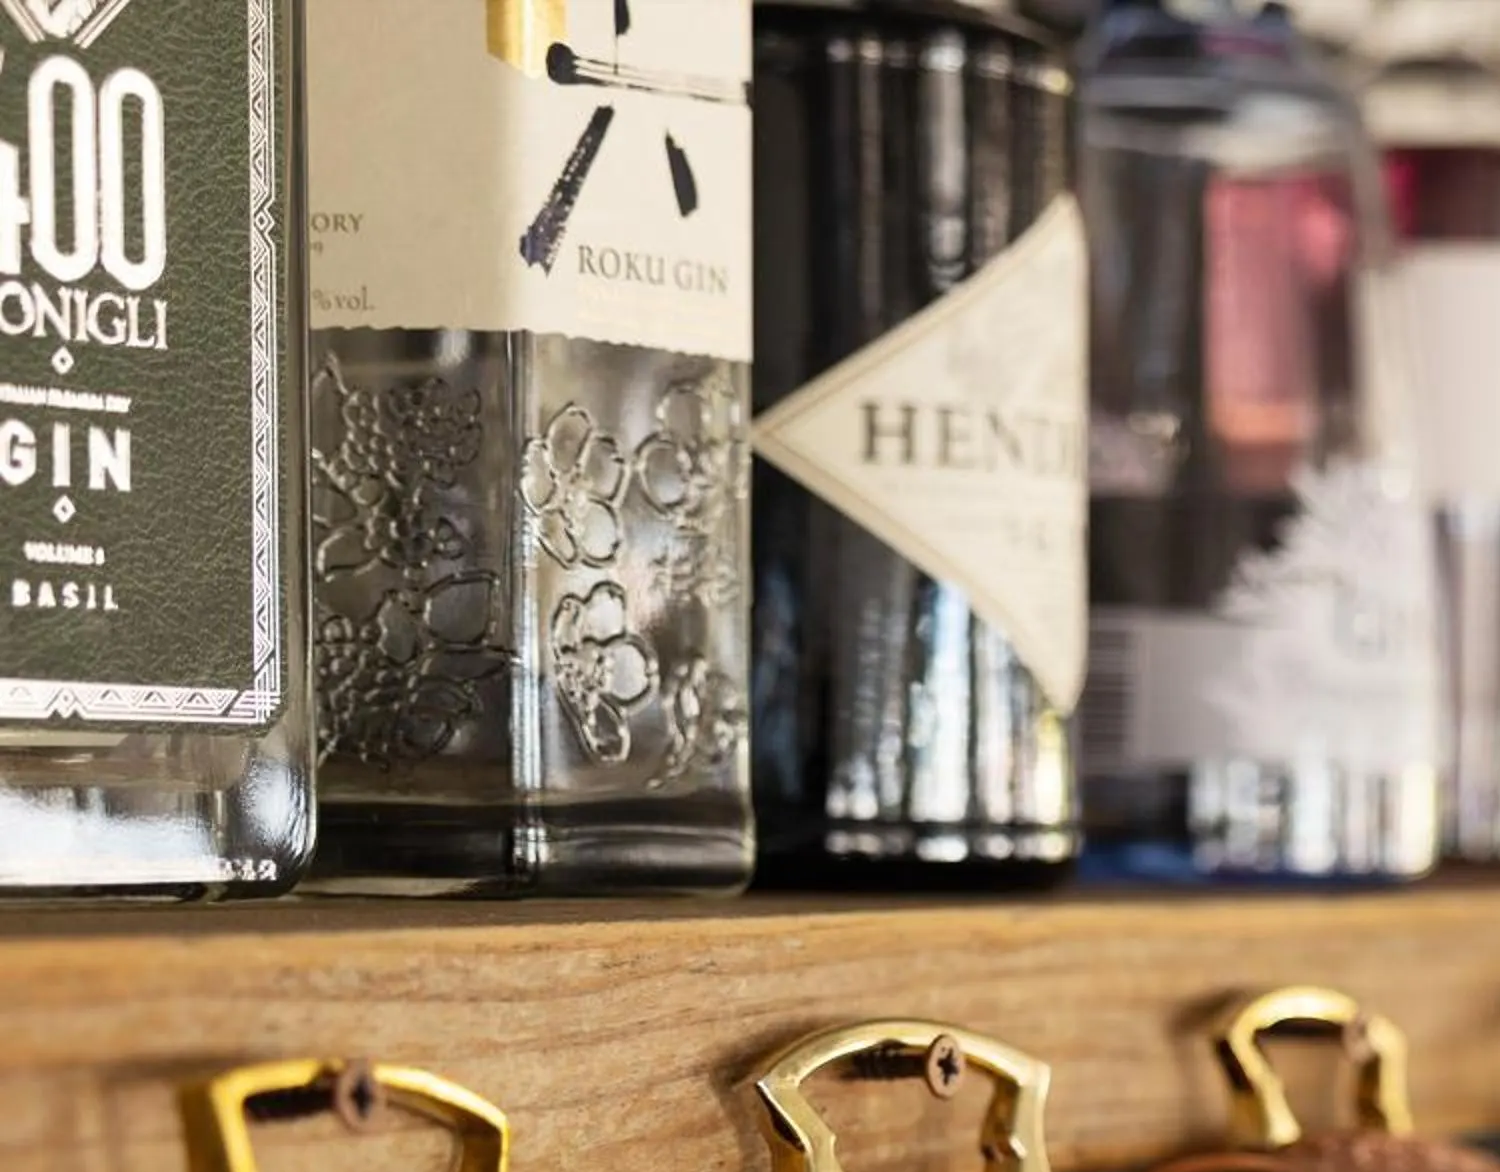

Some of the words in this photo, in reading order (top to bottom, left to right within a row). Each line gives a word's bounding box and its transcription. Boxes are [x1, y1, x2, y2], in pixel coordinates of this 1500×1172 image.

[578, 244, 666, 286] ROKU
[673, 258, 728, 294] GIN
[0, 418, 132, 492] GIN
[12, 579, 120, 611] BASIL
